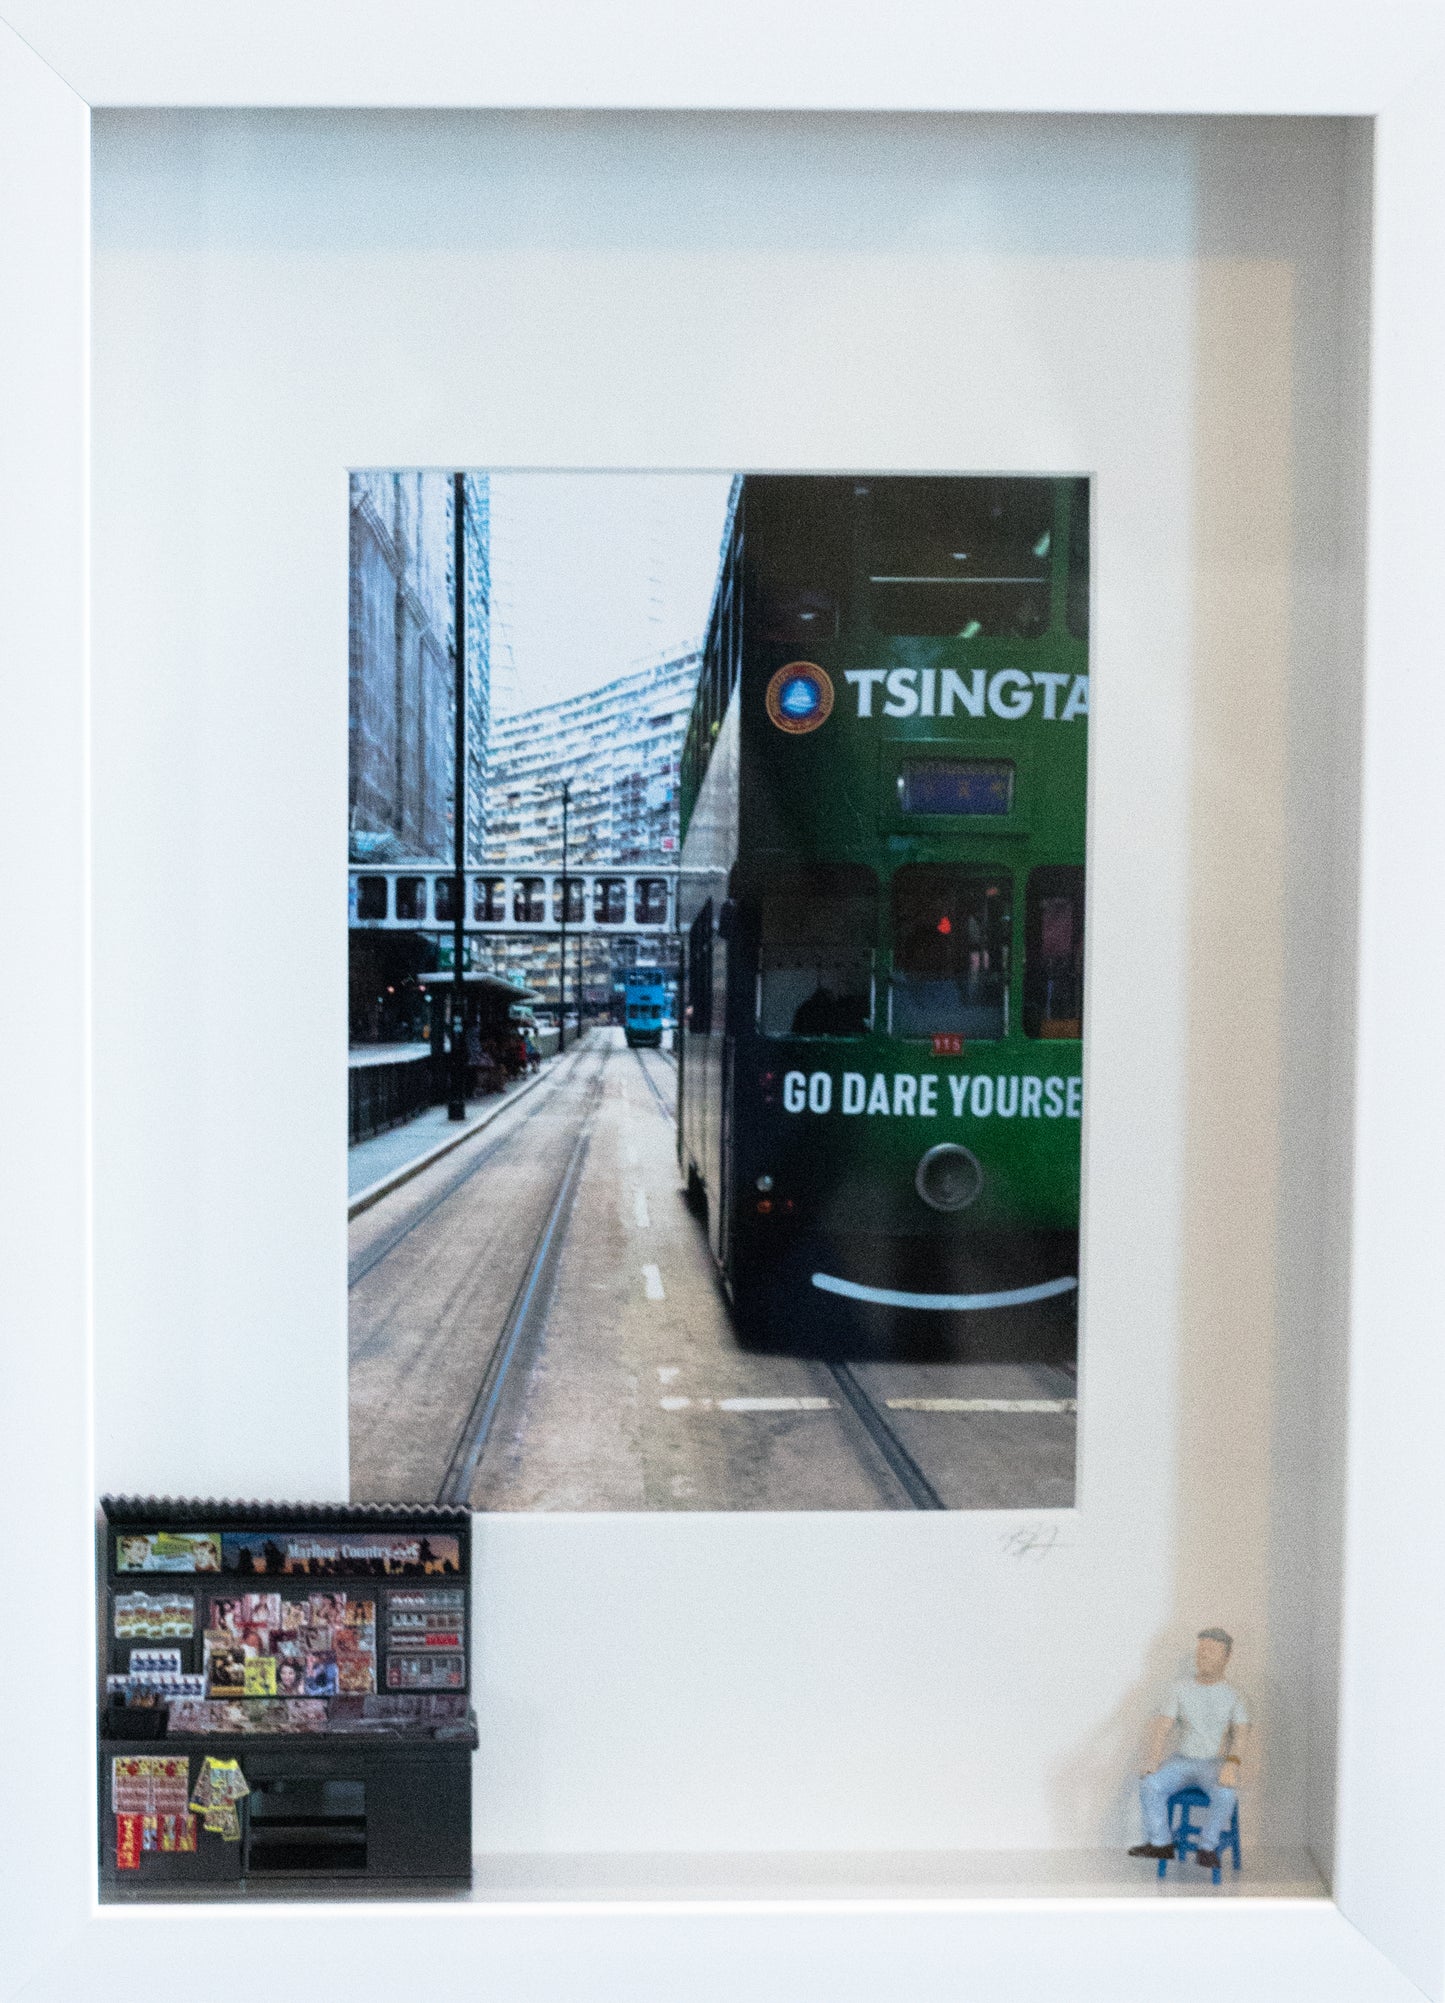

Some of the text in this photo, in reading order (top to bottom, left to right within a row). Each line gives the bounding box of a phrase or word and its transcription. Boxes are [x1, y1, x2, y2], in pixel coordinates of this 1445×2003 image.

[844, 668, 1089, 721] TSINGTA
[783, 1071, 1083, 1118] GO DARE YOURSE
